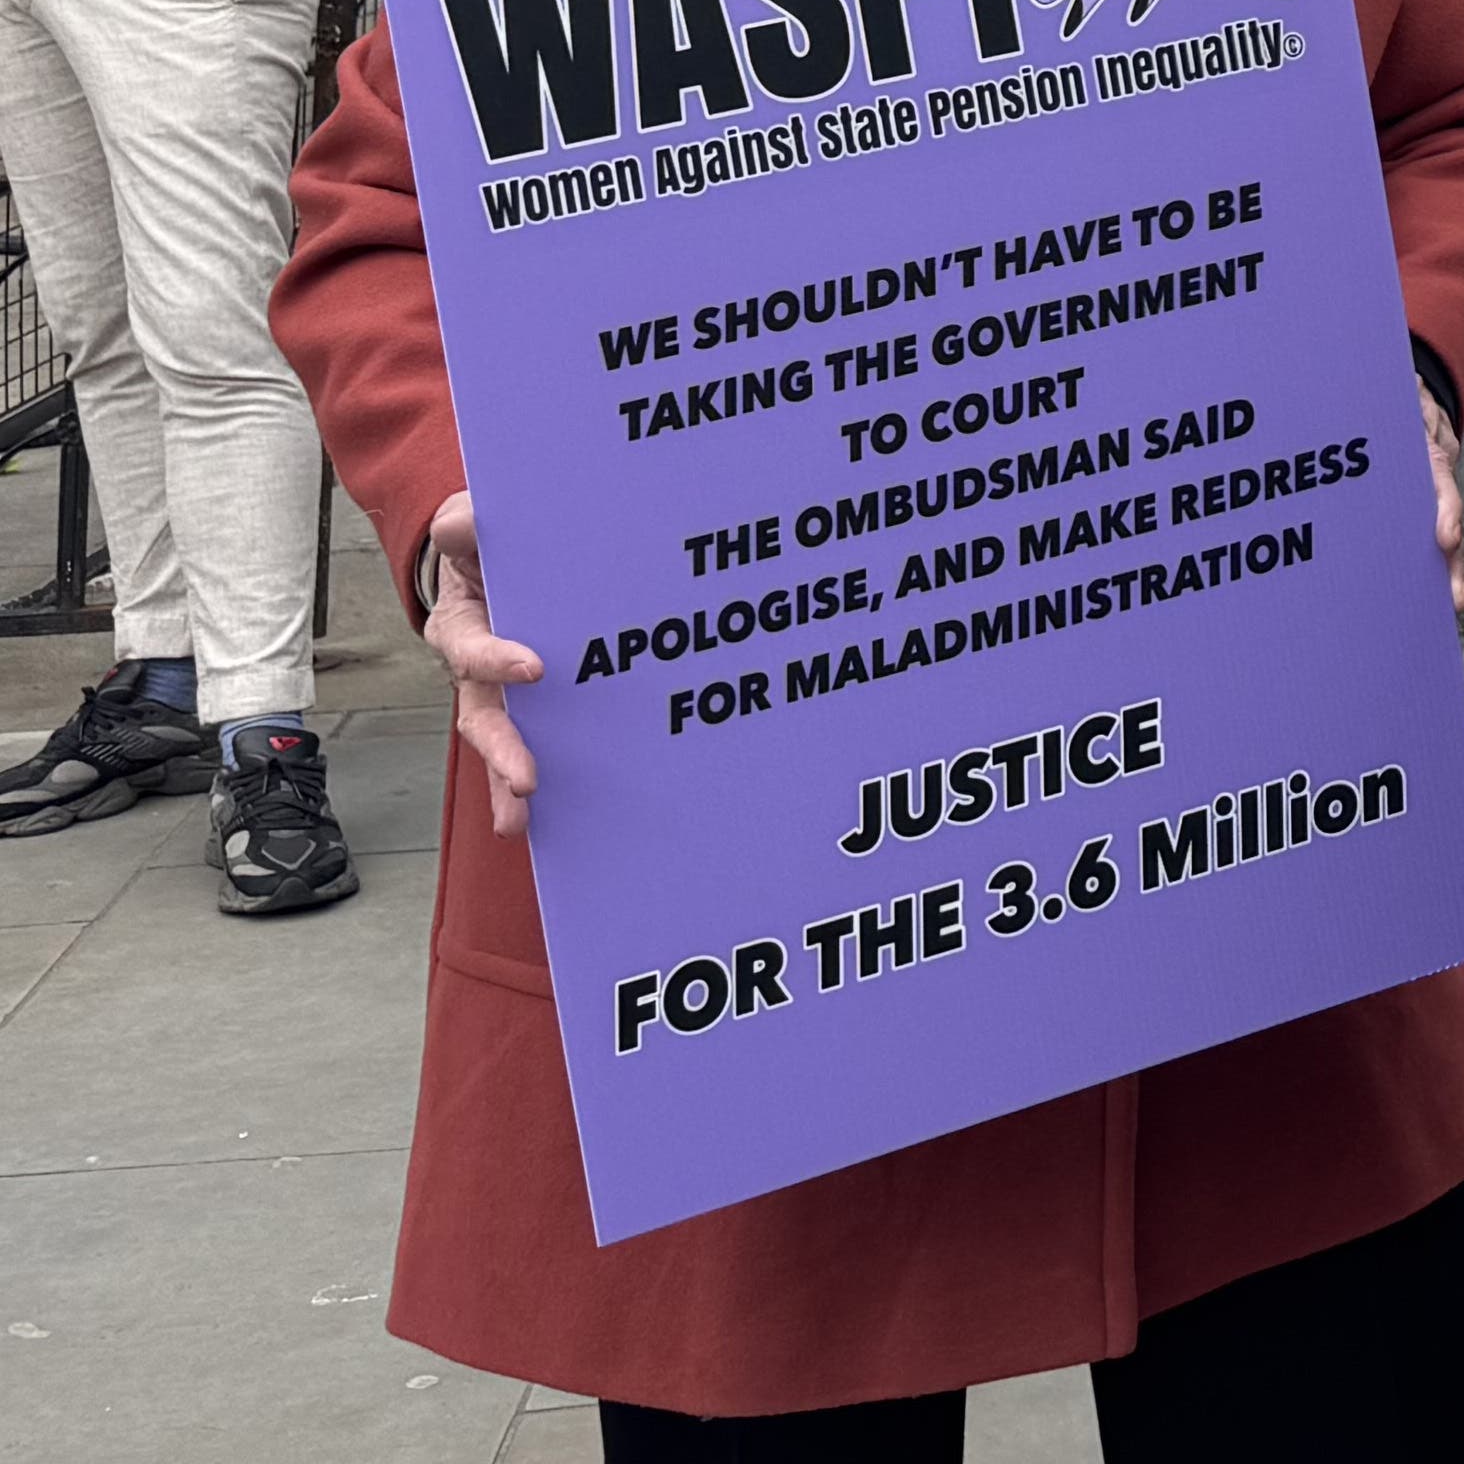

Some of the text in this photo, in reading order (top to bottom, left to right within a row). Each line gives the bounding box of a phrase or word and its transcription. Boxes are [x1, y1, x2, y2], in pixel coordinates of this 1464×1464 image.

[479, 155, 645, 232] Women
[653, 113, 811, 196] Against
[814, 95, 920, 160] State
[925, 62, 1088, 138] Pension
[596, 179, 1264, 372] WE SHOULDN’T HAVE TO BE
[616, 249, 1266, 443] TAKING THE GOVERNMENT
[682, 397, 1256, 578] THE OMBUDSMAN SAID
[838, 364, 1086, 464] TO COURT
[572, 434, 1371, 686] APOLOGISE, AND MAKE REDRESS
[668, 519, 1314, 737] FOR MALADMINISTRATION
[838, 698, 1163, 856] JUSTICE
[615, 760, 1412, 1054] FOR THE 3.6 Million
